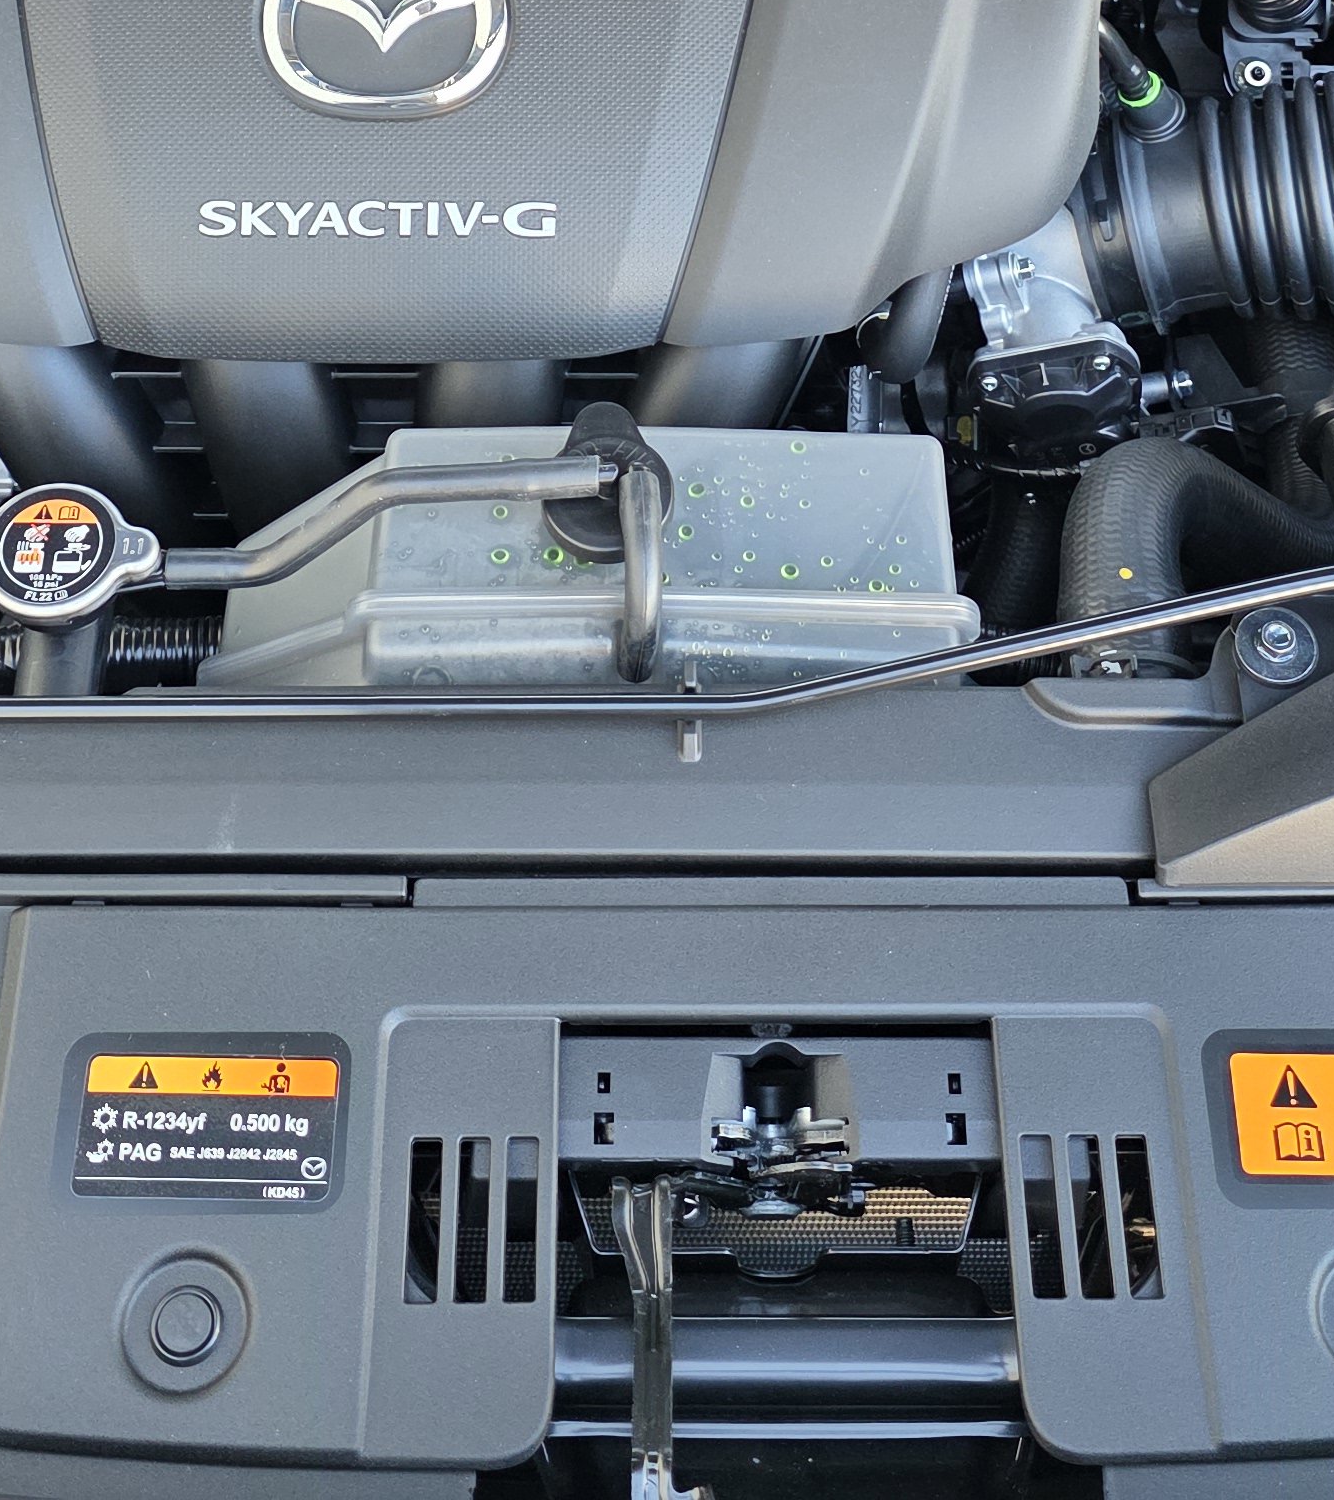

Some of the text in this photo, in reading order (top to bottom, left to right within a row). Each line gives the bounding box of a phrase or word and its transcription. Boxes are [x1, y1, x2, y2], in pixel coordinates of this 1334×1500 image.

[198, 200, 557, 238] SKYACTIV-G
[122, 537, 143, 555] 1.1
[23, 590, 53, 602] FL22
[122, 1111, 309, 1136] R-1234yf 0.500 kg
[118, 1143, 299, 1162] PAG SAE J639 J2842 J2845
